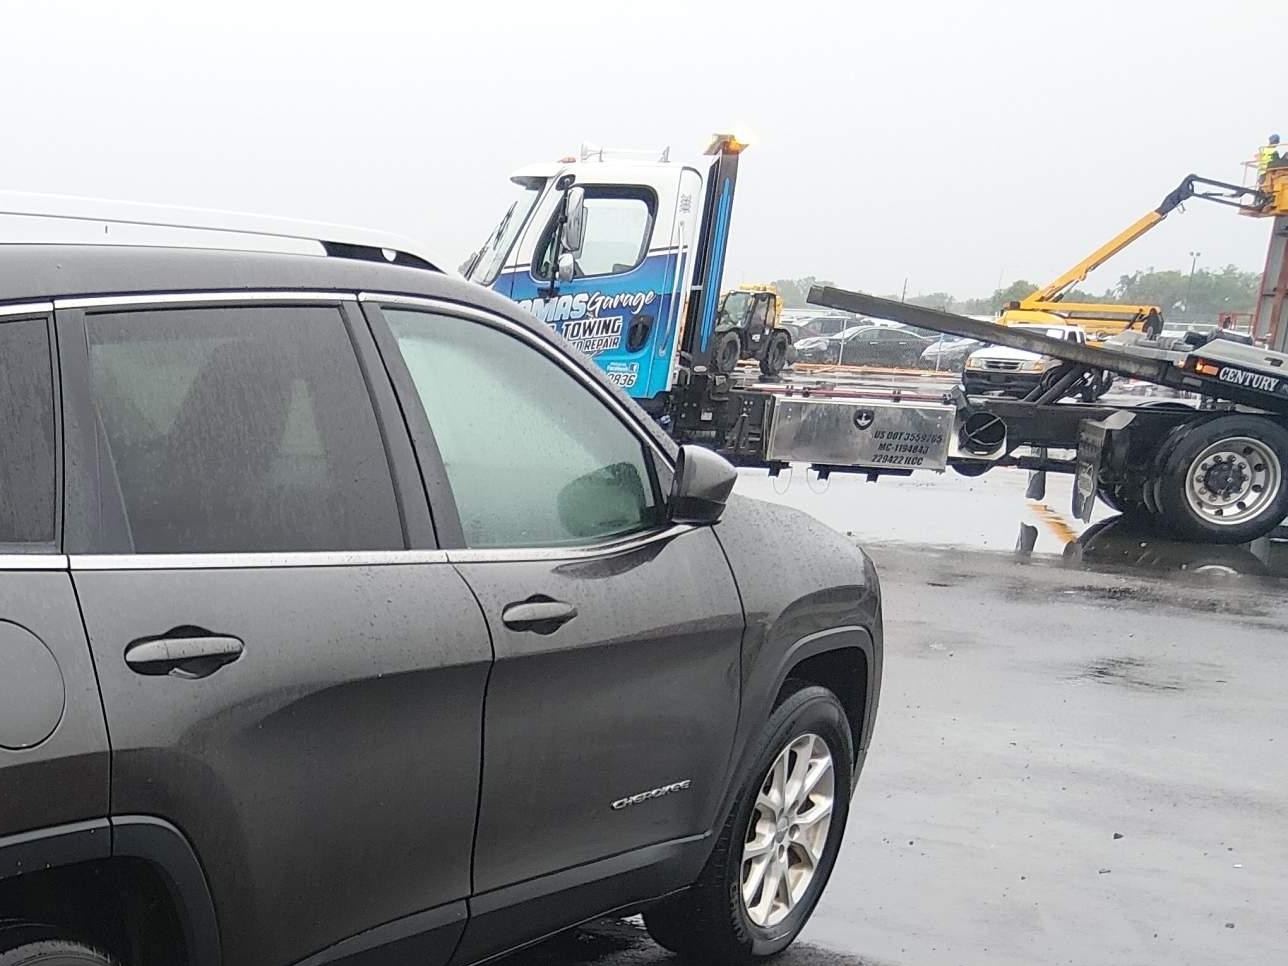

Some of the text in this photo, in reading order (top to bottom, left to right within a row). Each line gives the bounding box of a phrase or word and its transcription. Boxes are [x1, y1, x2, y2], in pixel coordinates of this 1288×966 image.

[587, 290, 657, 317] Garage
[563, 317, 622, 340] TOWING
[584, 336, 620, 352] REPAIR
[1219, 366, 1280, 392] CENTURY
[874, 430, 886, 440] US
[886, 431, 905, 441] DOT
